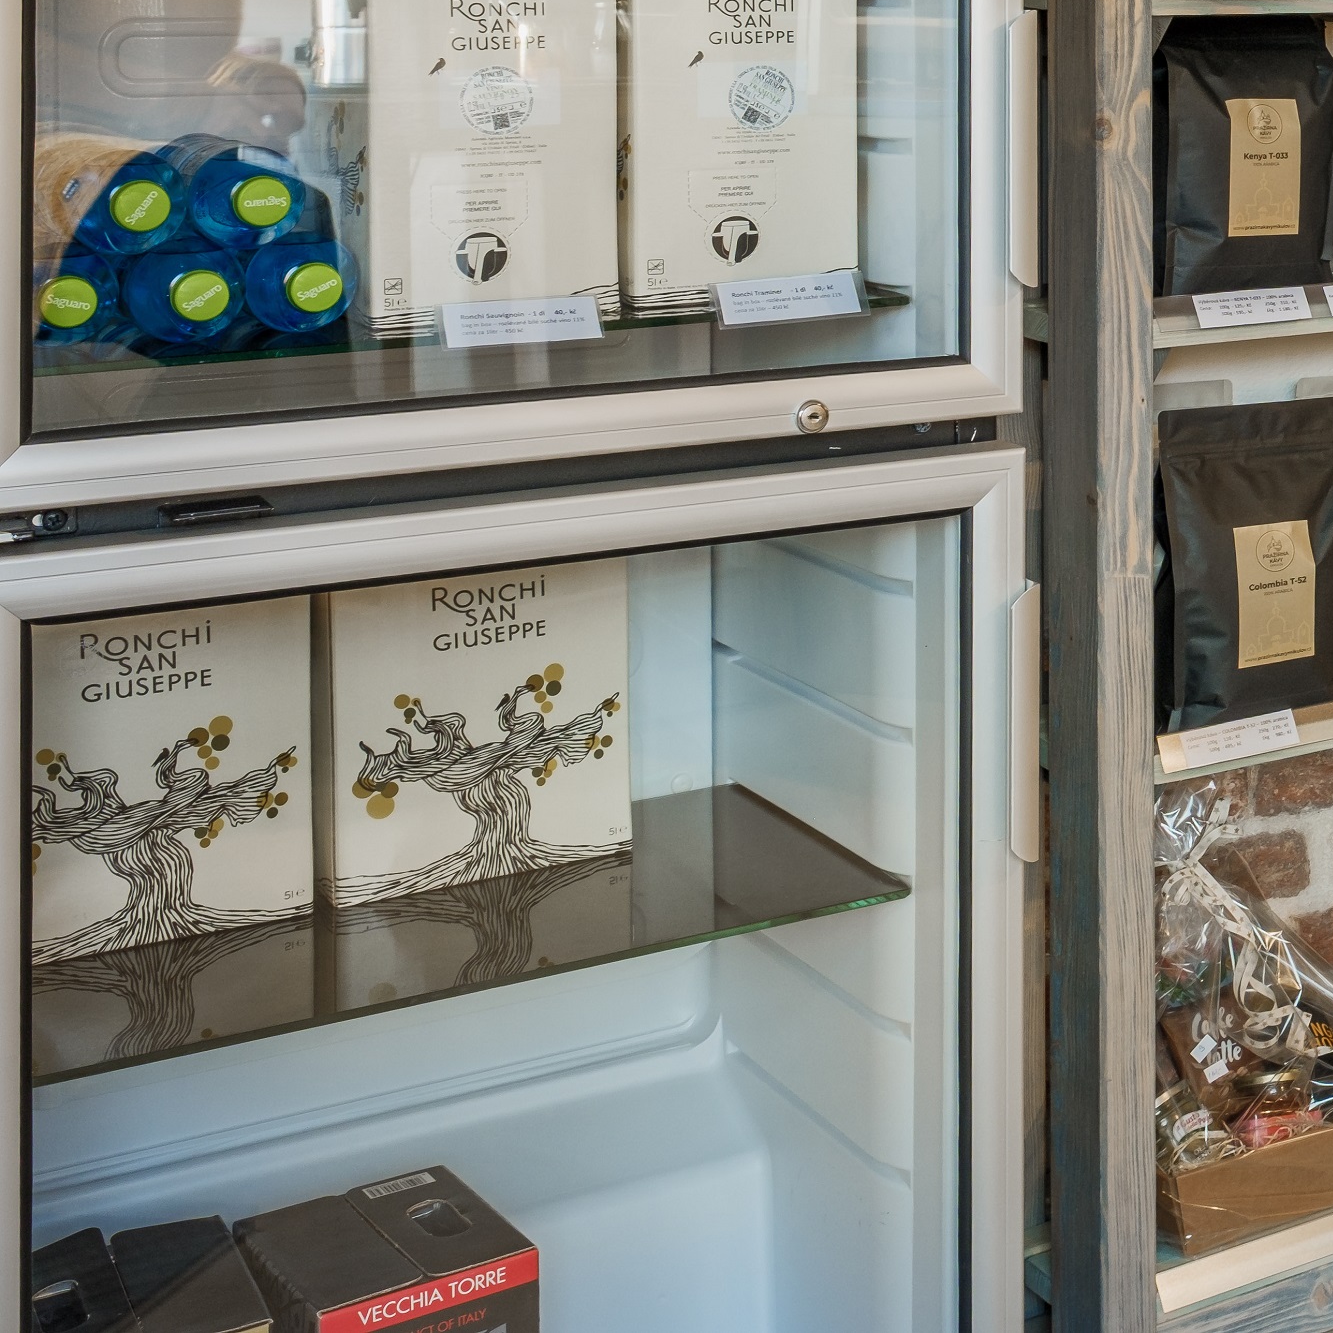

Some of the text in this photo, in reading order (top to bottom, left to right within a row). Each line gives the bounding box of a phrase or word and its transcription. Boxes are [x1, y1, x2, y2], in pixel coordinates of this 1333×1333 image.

[734, 15, 771, 28] SAN
[452, 36, 545, 50] GIUSEPPE
[709, 31, 794, 44] GIUSEPPE
[1244, 153, 1267, 161] Kenya
[124, 191, 158, 226] Saguaro
[244, 196, 287, 207] Saguaro
[182, 284, 222, 311] Saguaro
[297, 279, 337, 300] Saguaro
[45, 295, 91, 310] Saguaro
[1249, 576, 1307, 591] Colombia T-52
[465, 606, 517, 627] SAN
[433, 620, 546, 652] GIUSEPPE
[118, 651, 177, 677] SAN
[81, 669, 213, 703] GIUSEPPE
[358, 1267, 507, 1325] VECCHIA TORRE
[437, 1308, 486, 1333] OF ITALY
